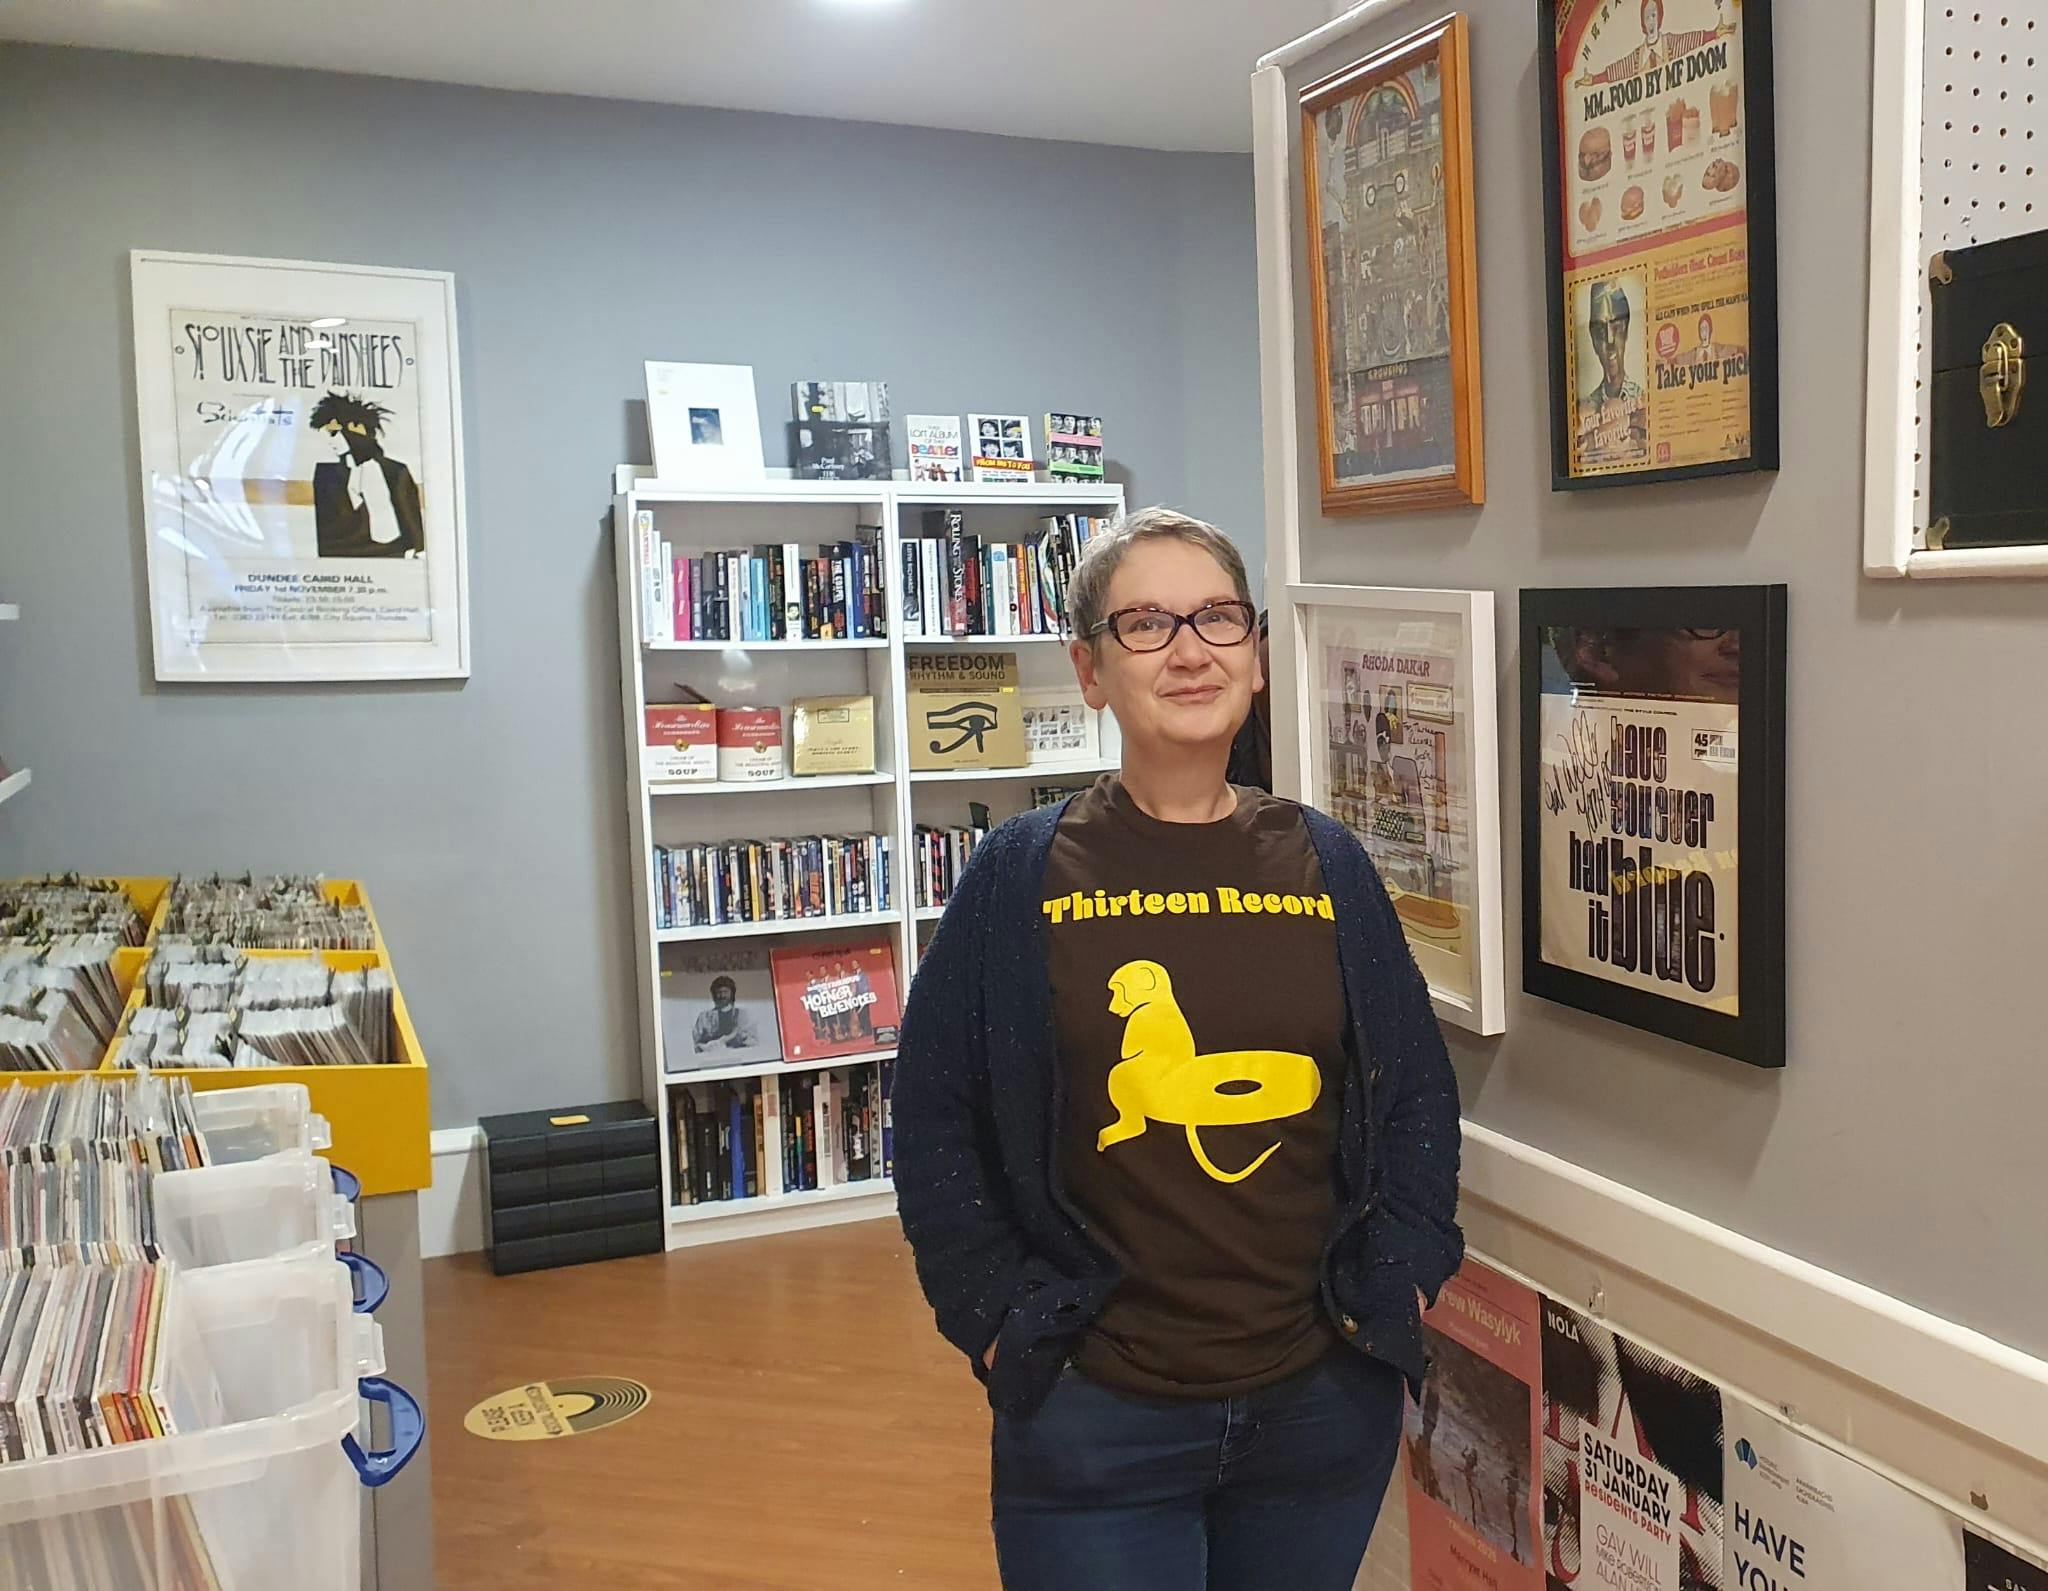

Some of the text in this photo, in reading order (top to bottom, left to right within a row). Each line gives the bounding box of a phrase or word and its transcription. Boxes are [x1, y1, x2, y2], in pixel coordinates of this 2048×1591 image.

[1645, 68, 1663, 98] BY
[1665, 60, 1684, 91] MF
[1687, 42, 1728, 82] DOOM
[278, 325, 315, 356] AND
[278, 357, 316, 389] THE
[319, 332, 403, 389] BANSHEES
[1656, 361, 1686, 391] Take
[1688, 359, 1720, 391] your
[911, 443, 960, 457] BEATLES
[929, 429, 959, 440] ALBUM
[1017, 460, 1032, 471] YOU
[950, 513, 962, 557] ROLLING
[234, 584, 271, 593] FRIDAY
[289, 585, 347, 594] NOVEMBER
[248, 574, 299, 585] DUNDEE
[343, 574, 374, 585] HALL
[909, 655, 1005, 672] FREEDOM
[910, 670, 1006, 681] RHYTHM & SOUND
[1362, 654, 1431, 678] RHODA DAKAR
[1694, 733, 1708, 747] 45
[667, 768, 699, 777] SOUP
[747, 769, 775, 778] SOUP
[1610, 782, 1654, 839] you
[1042, 888, 1210, 925] Thirteen
[1569, 830, 1726, 994] had it blue.
[801, 984, 853, 1013] HOFNER
[1467, 1296, 1521, 1346] Wasylyk
[1548, 1310, 1580, 1345] NOLA
[1584, 1431, 1670, 1504] SATURDAY
[1584, 1458, 1671, 1529] 31 JANUARY
[1640, 1515, 1672, 1546] PARTY
[1734, 1501, 1806, 1579] HAVE
[1596, 1523, 1662, 1586] GAV WILL
